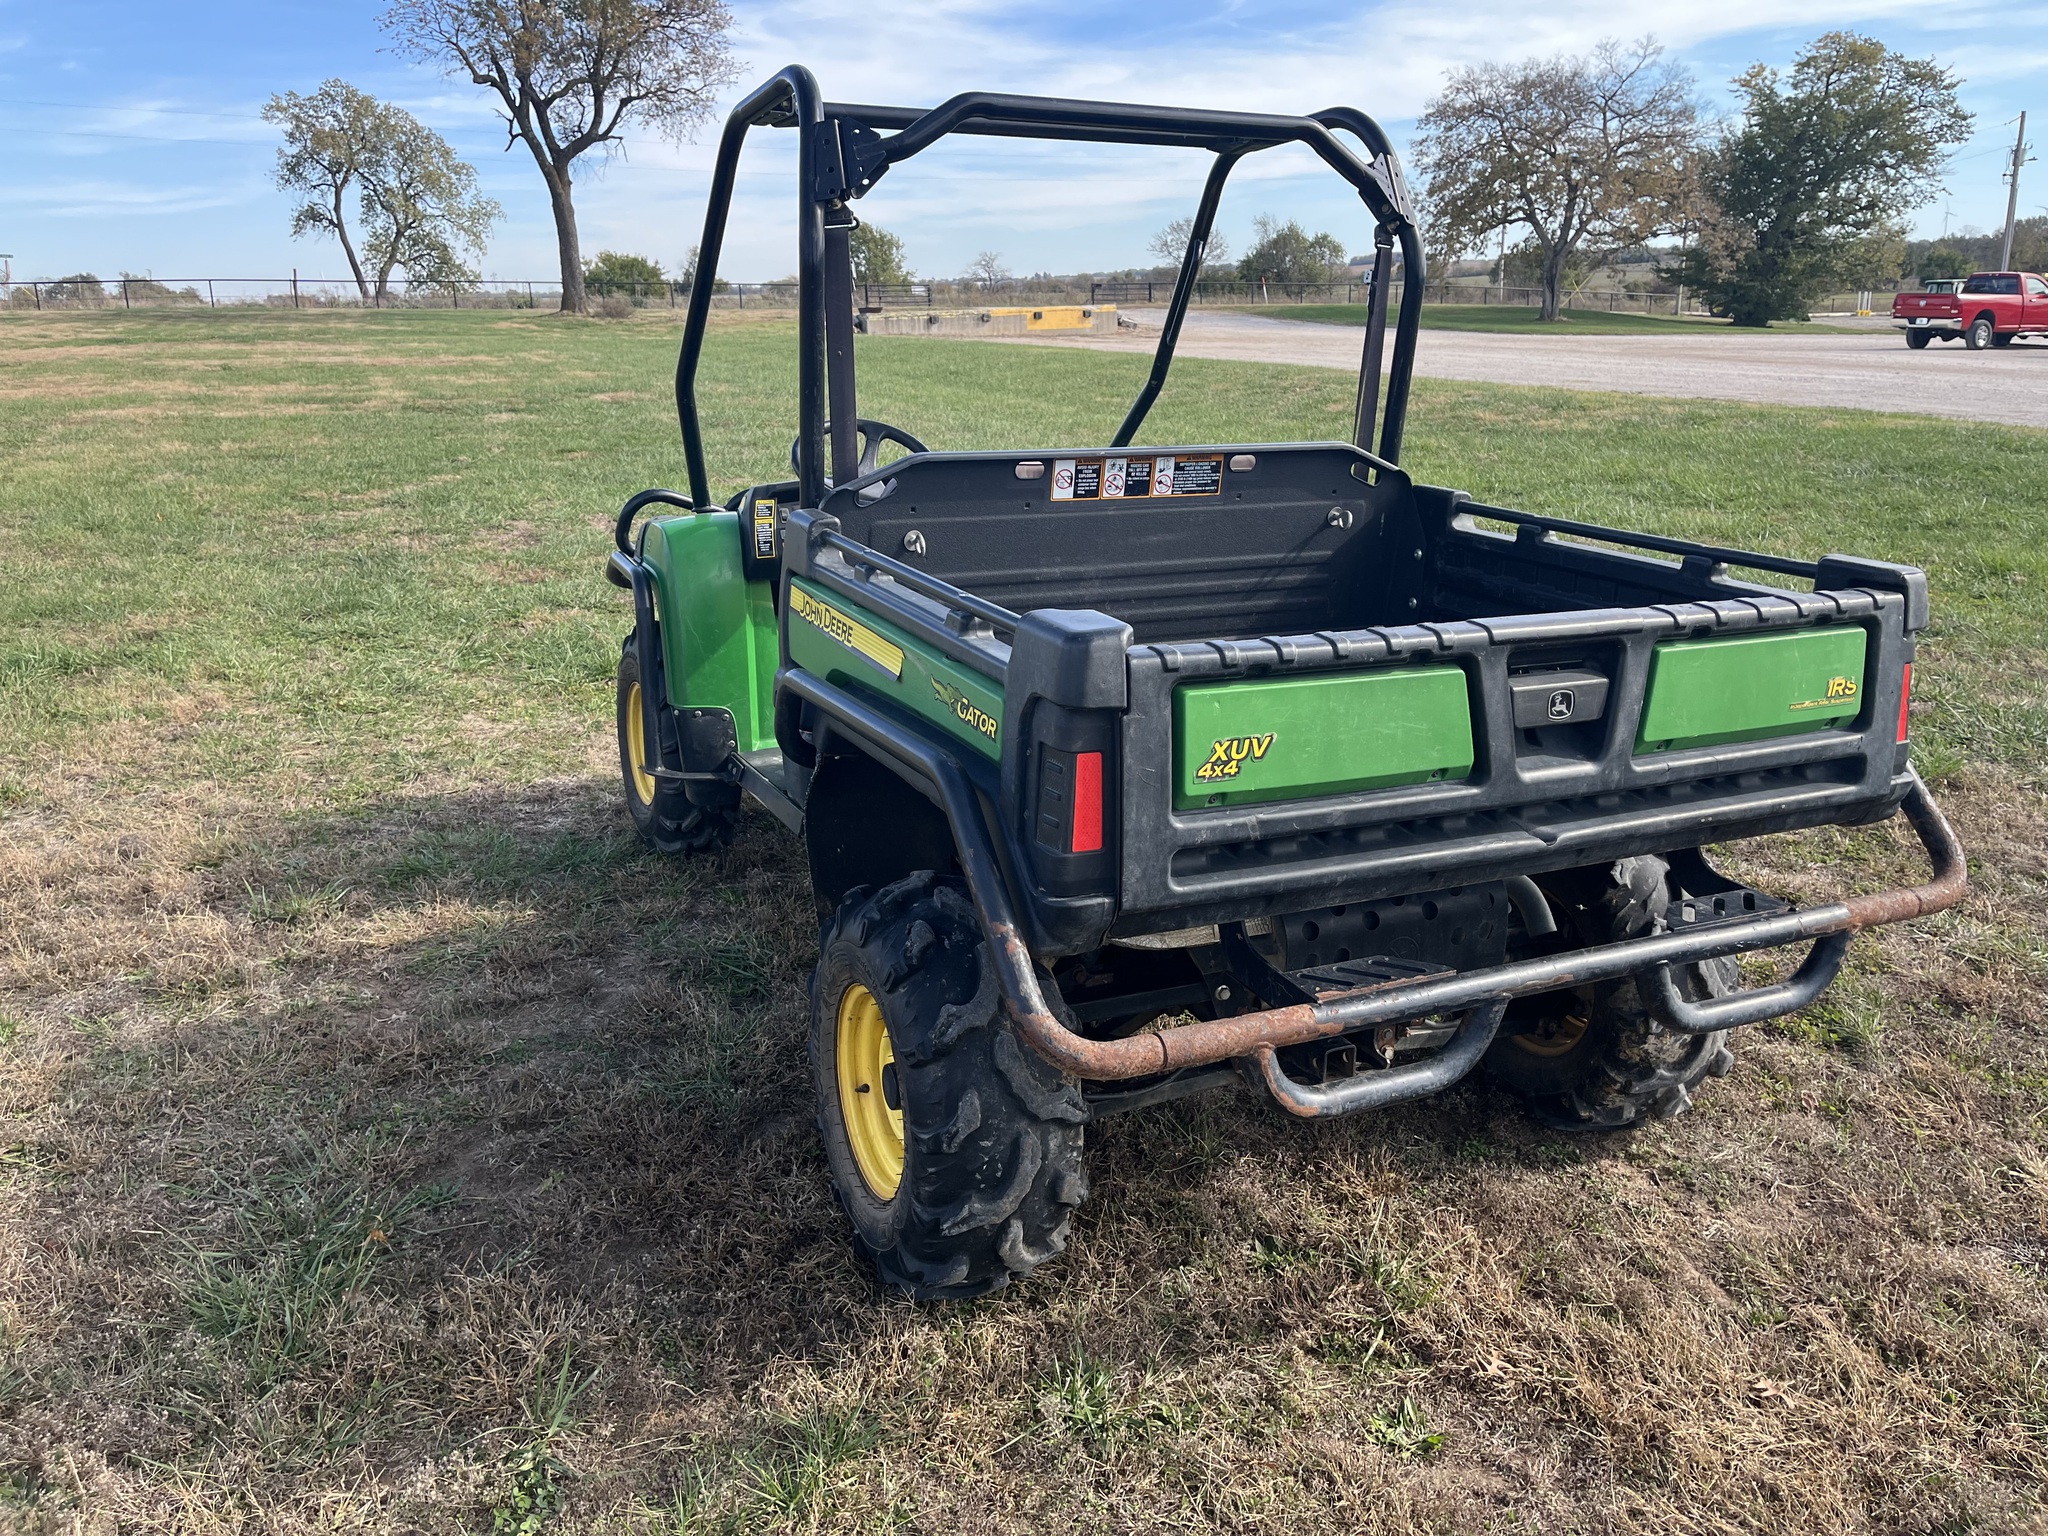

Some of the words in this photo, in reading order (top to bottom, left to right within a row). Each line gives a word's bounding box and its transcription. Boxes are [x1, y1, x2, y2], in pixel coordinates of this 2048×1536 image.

[799, 595, 823, 627] JOHN
[823, 607, 854, 645] DEERE
[1826, 678, 1858, 698] IRS
[956, 696, 997, 740] GATOR
[1208, 735, 1273, 763] XUV
[1197, 759, 1239, 778] 4x4
